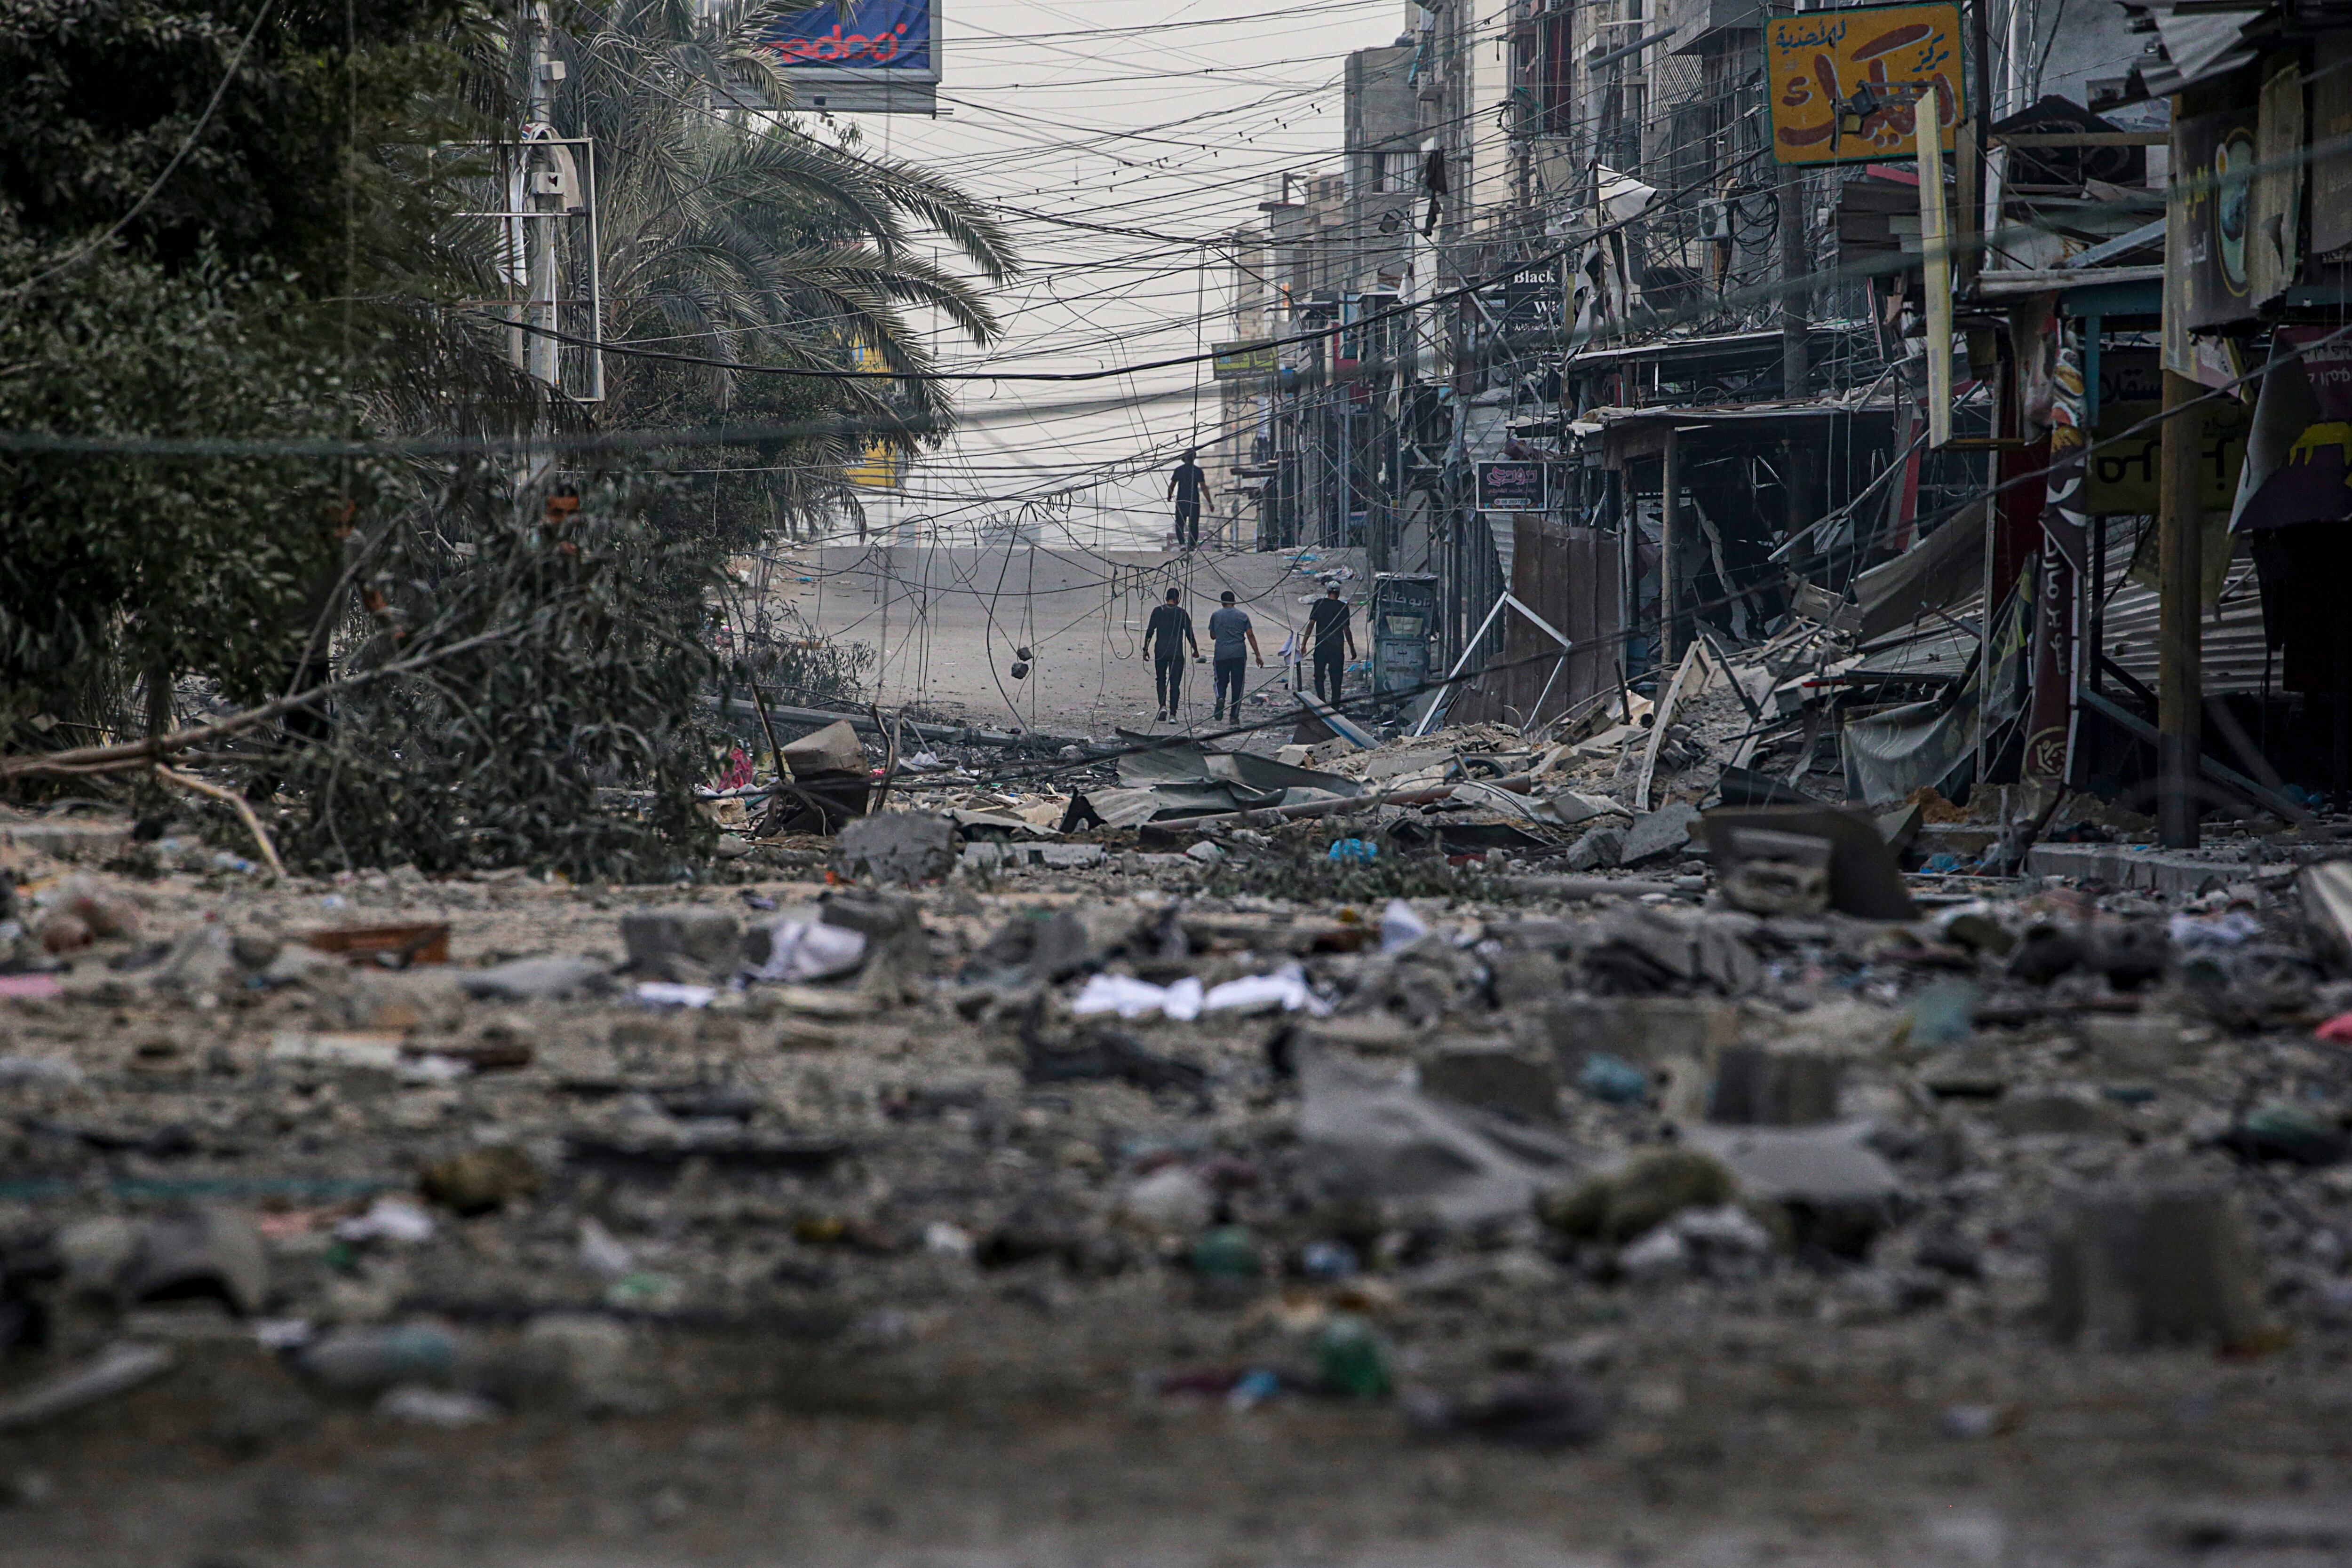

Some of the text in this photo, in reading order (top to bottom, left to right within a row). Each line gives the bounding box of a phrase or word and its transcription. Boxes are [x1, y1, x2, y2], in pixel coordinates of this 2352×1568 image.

[1912, 33, 1950, 73] مركز
[1513, 270, 1556, 283] Black
[2046, 607, 2068, 676] سوبر
